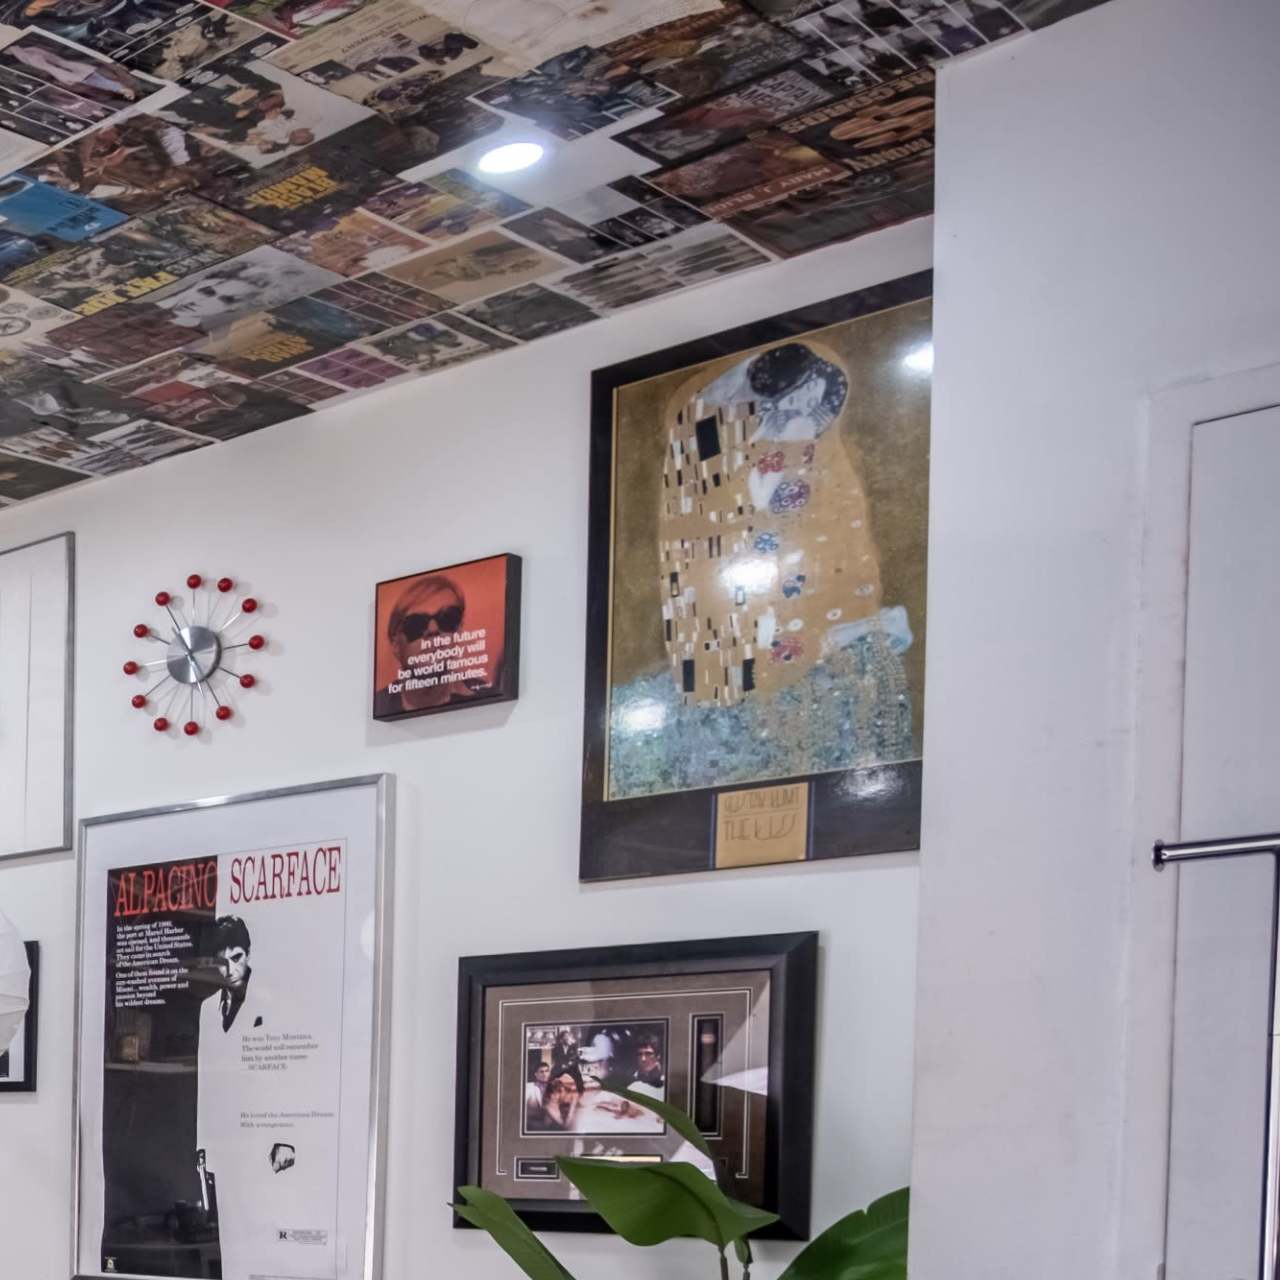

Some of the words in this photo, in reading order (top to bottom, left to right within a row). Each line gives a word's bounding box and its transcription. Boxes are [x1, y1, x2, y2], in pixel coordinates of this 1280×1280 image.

[421, 638, 431, 650] In
[433, 635, 451, 647] the
[453, 628, 486, 643] future
[408, 645, 464, 665] everybody
[467, 640, 486, 653] will
[398, 667, 411, 679] be
[414, 661, 444, 676] world
[446, 654, 489, 670] famous
[388, 681, 402, 694] for
[405, 674, 438, 692] fifteen
[440, 667, 487, 684] minutes.
[114, 872, 141, 917] AL
[142, 860, 217, 914] PACINO
[230, 846, 341, 904] SCARFACE
[279, 1230, 288, 1240] R
